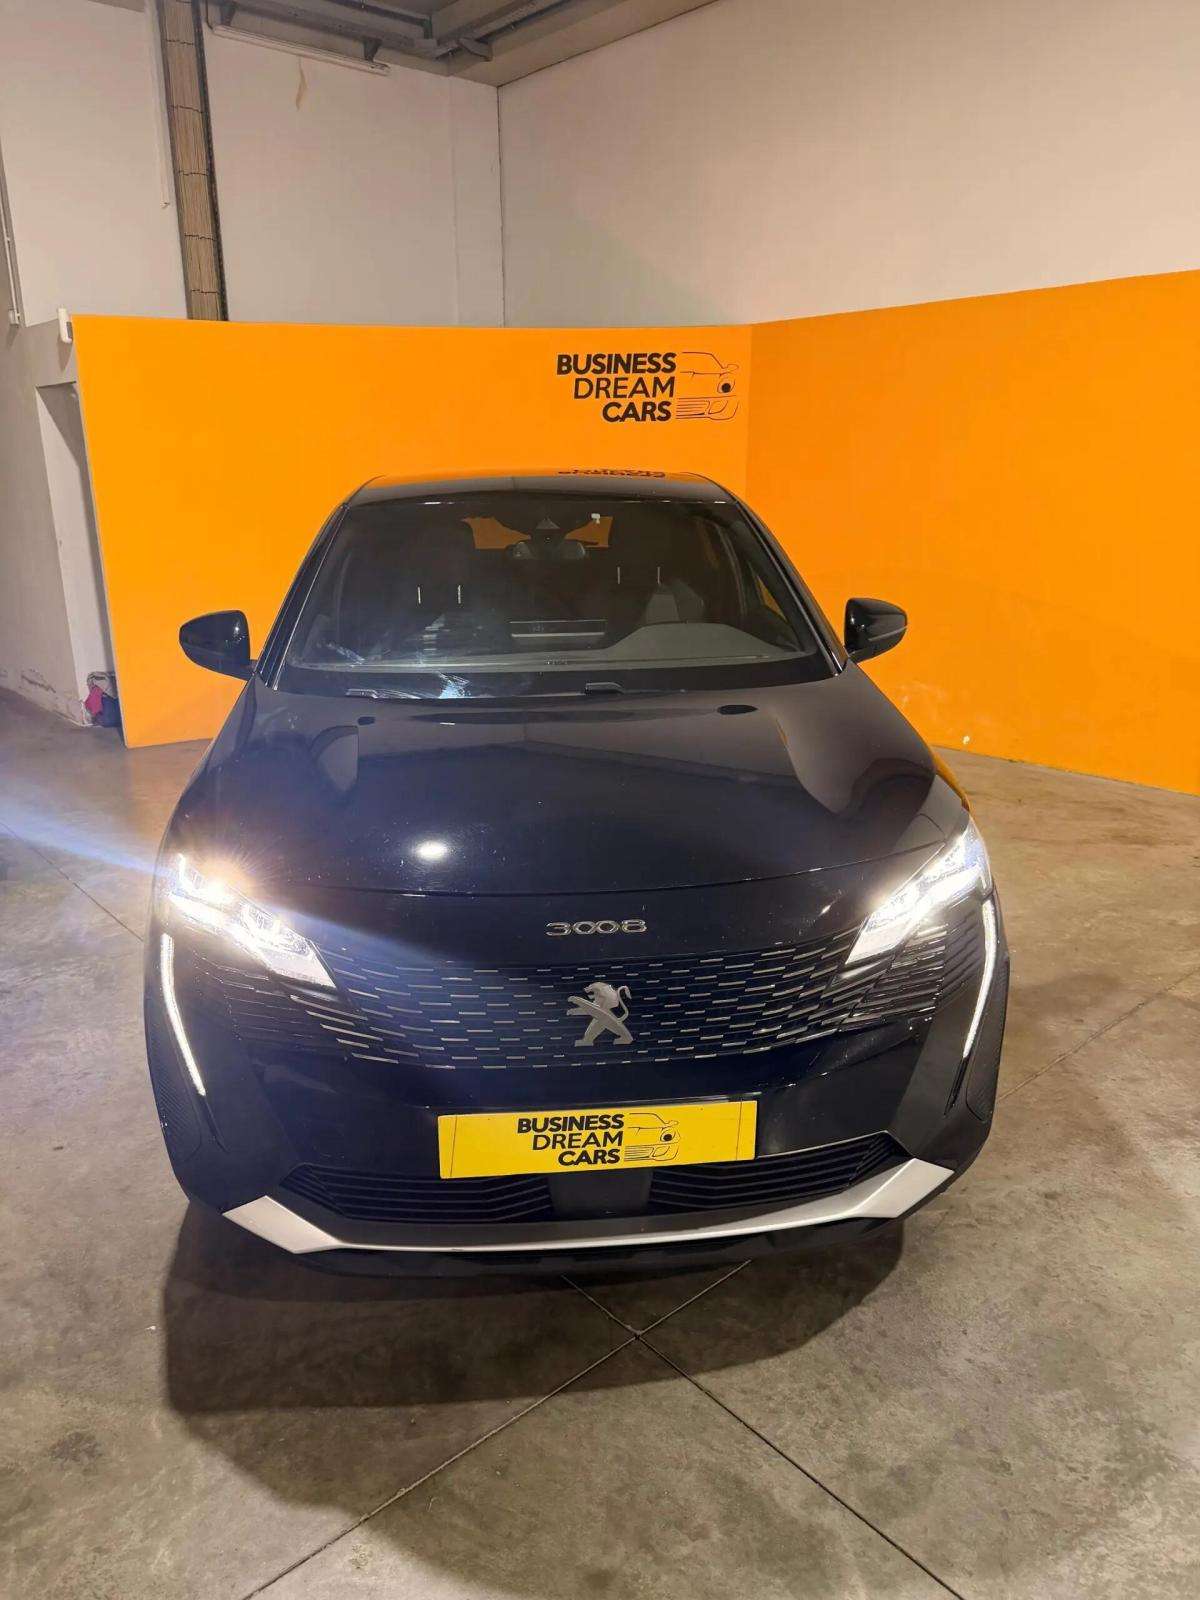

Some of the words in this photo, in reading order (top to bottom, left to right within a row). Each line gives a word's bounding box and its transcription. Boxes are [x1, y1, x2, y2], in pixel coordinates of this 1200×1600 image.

[557, 352, 677, 375] BUSINESS
[574, 376, 676, 399] DREAM
[602, 401, 672, 422] CARS
[545, 919, 648, 936] 3008
[517, 1113, 625, 1134] BUSINESS
[532, 1131, 624, 1150] DREAM
[558, 1148, 621, 1166] CARS
